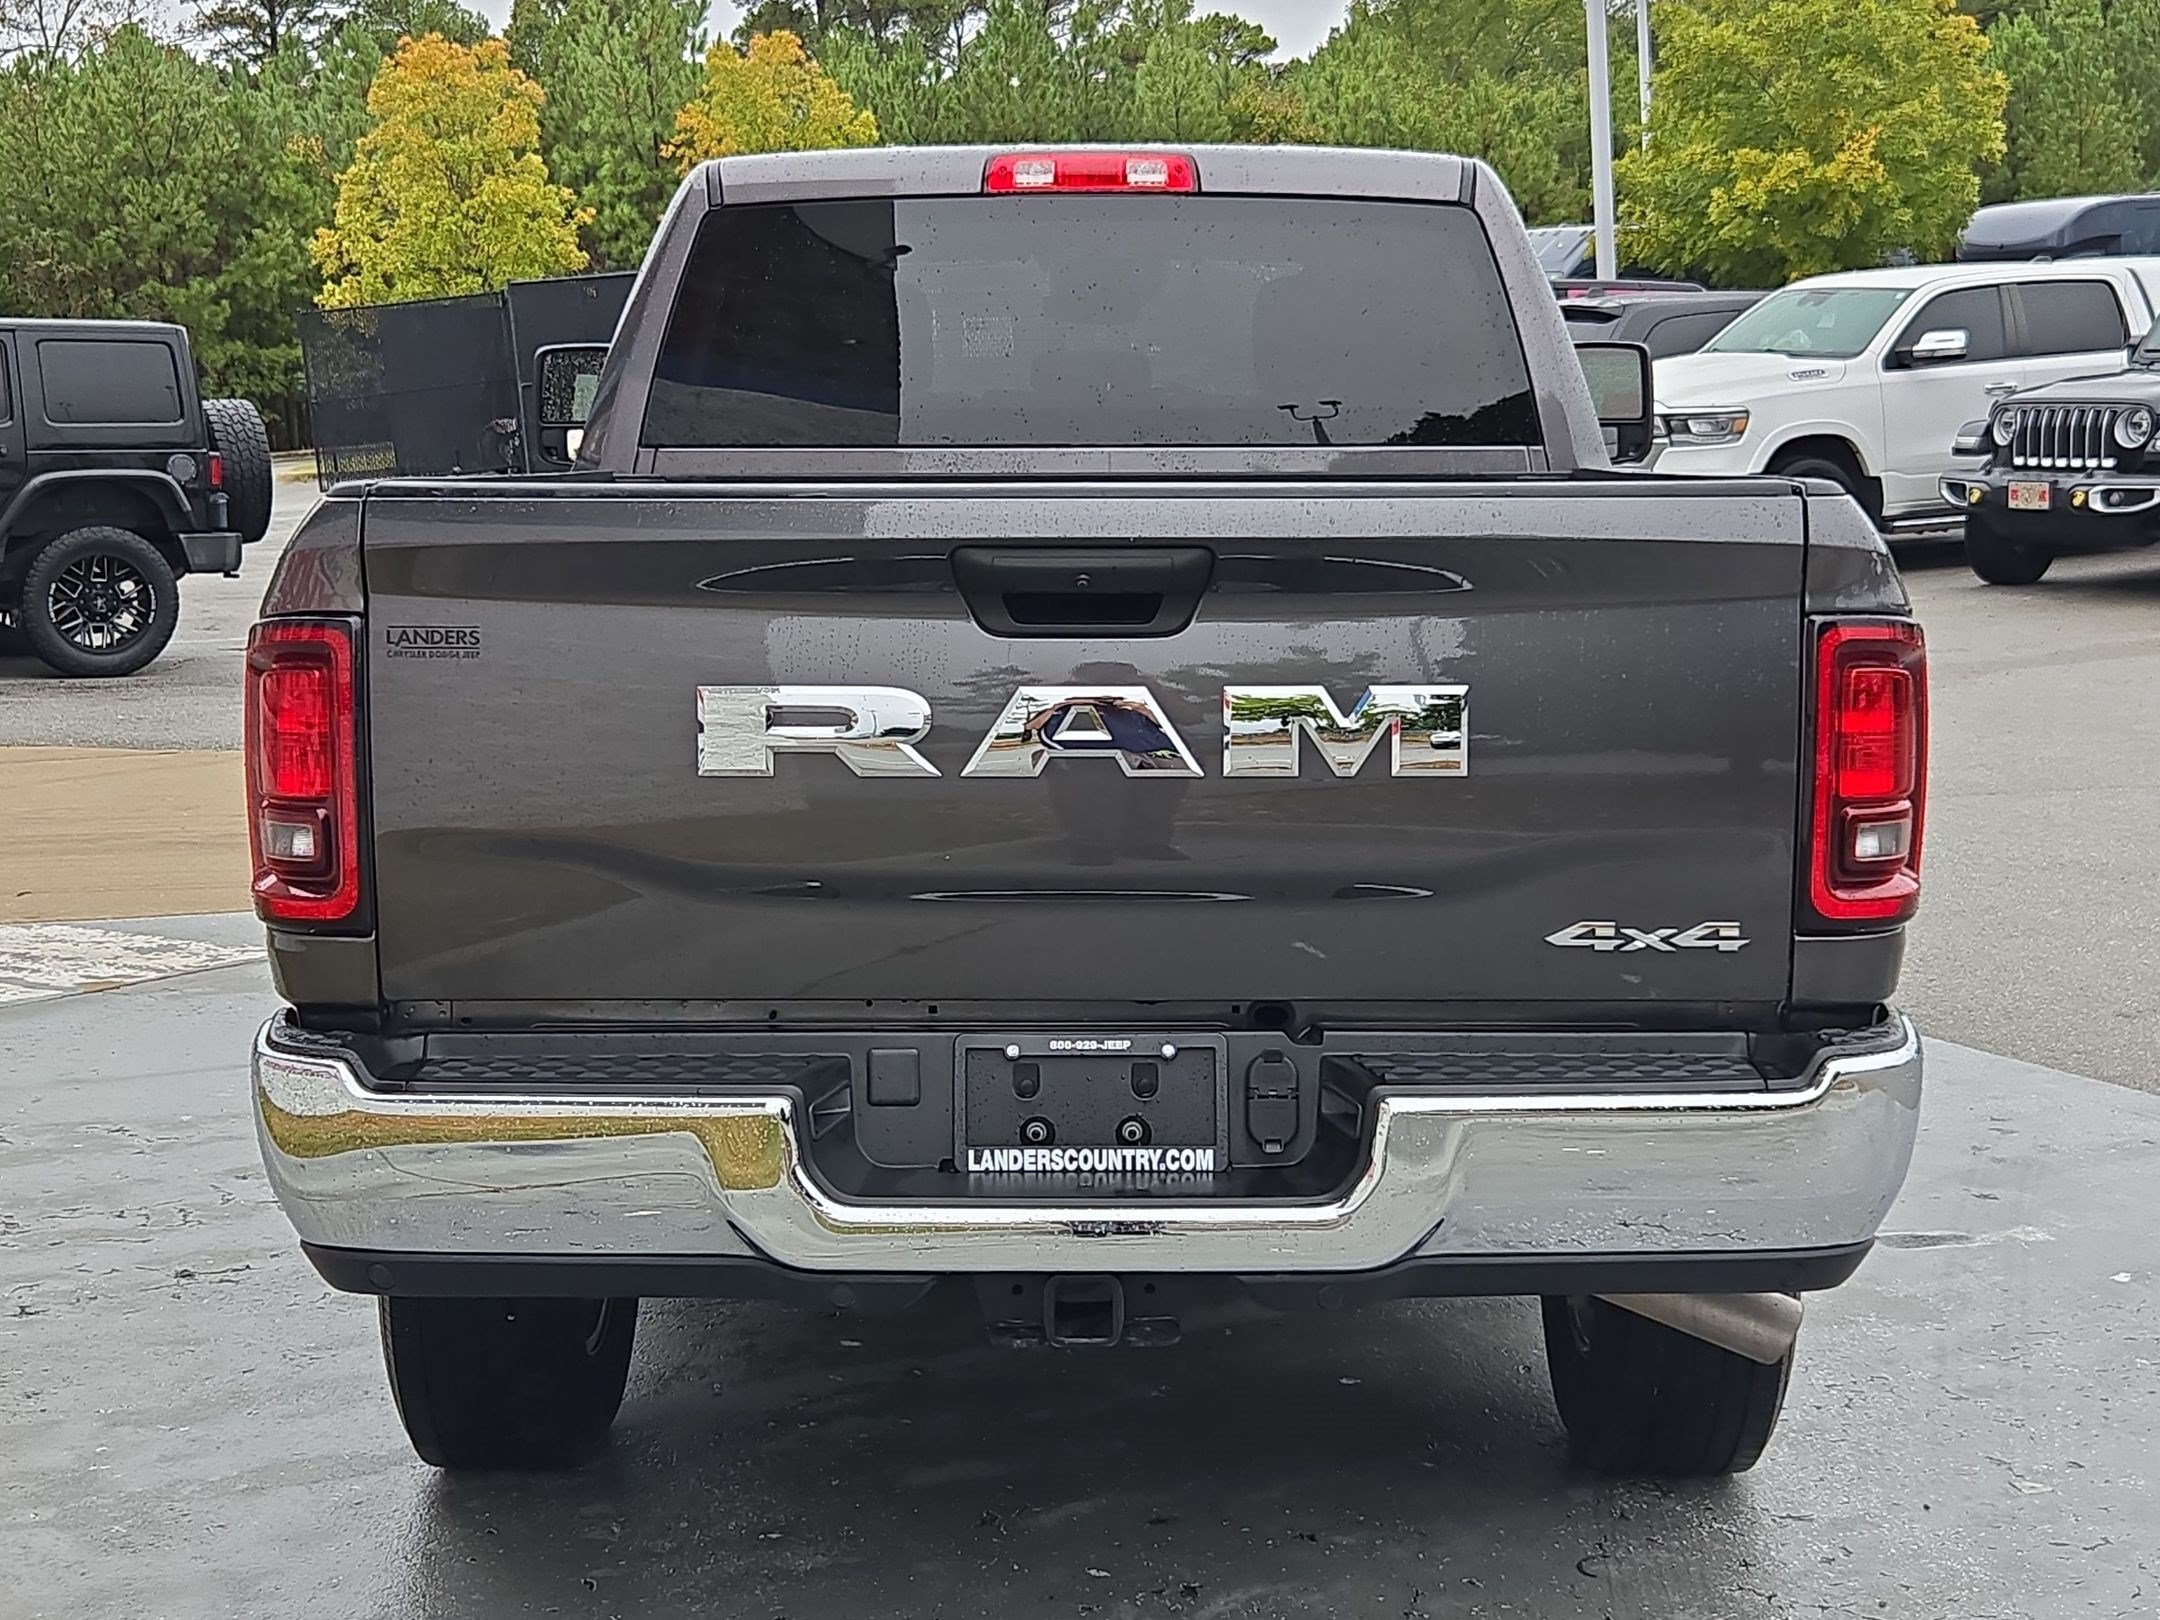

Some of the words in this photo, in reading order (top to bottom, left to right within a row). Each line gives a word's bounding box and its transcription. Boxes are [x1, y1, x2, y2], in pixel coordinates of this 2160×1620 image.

[386, 629, 480, 646] LANDERS
[697, 685, 1471, 778] RAM
[967, 1148, 1214, 1172] LANDERSCOUNTRY.COM
